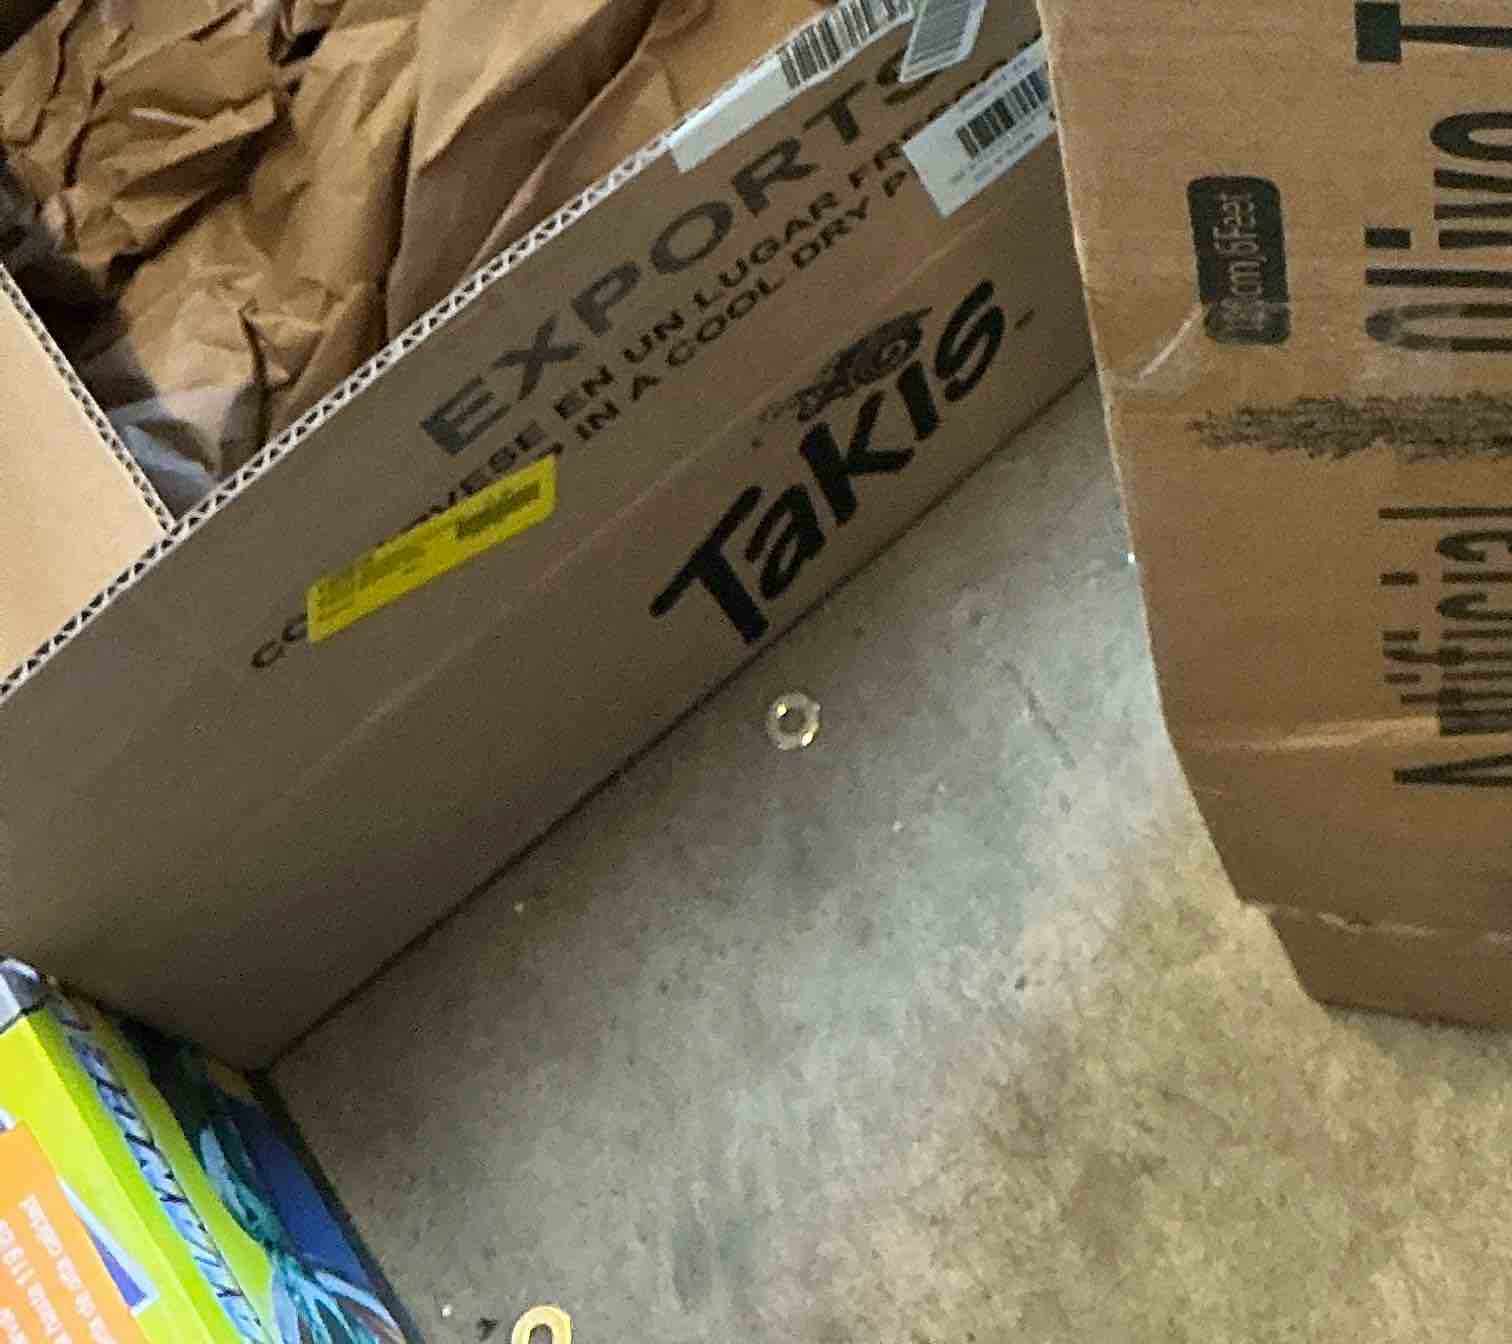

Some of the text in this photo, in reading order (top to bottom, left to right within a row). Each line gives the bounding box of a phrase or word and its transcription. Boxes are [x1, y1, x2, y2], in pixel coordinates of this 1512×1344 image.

[420, 47, 940, 455] EXPORTS
[553, 364, 614, 419] EN
[623, 311, 686, 364] UN
[693, 192, 839, 310] LUGAR
[574, 196, 870, 442] IN A COOL DRY
